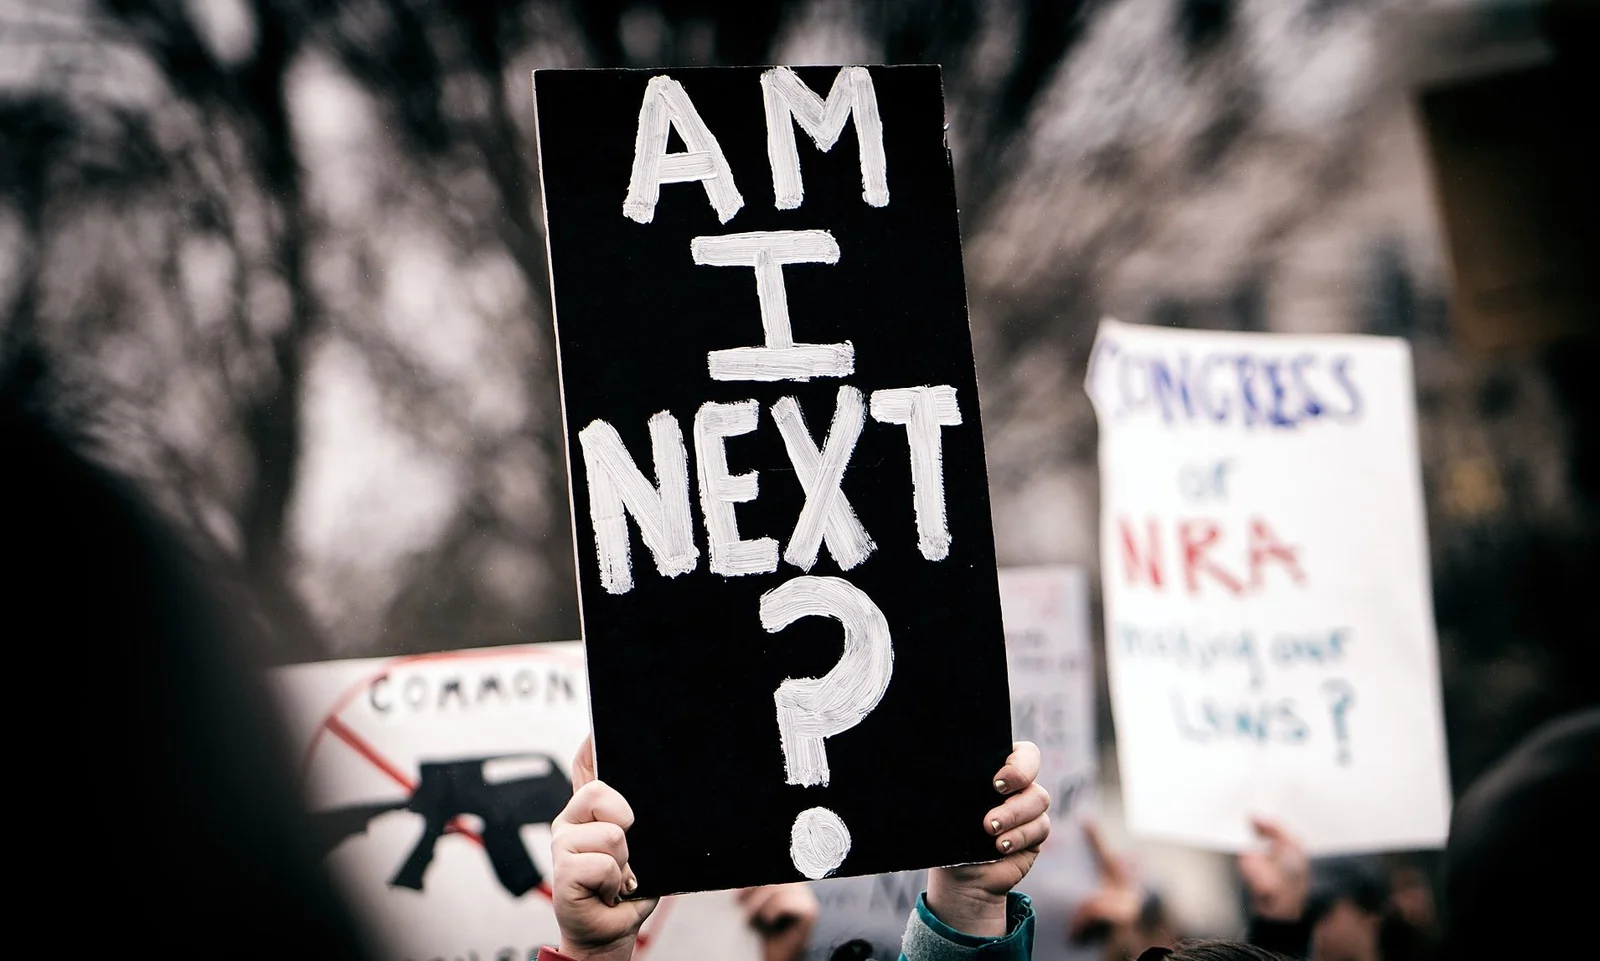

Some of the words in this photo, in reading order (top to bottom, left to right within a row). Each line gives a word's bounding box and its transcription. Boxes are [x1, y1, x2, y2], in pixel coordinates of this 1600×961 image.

[623, 67, 889, 225] AM
[690, 229, 855, 382] I
[1087, 338, 1364, 430] CONGRESS
[579, 384, 963, 595] NEXT
[1118, 516, 1307, 597] NRA
[369, 671, 577, 713] COMMON
[759, 575, 894, 880] ?
